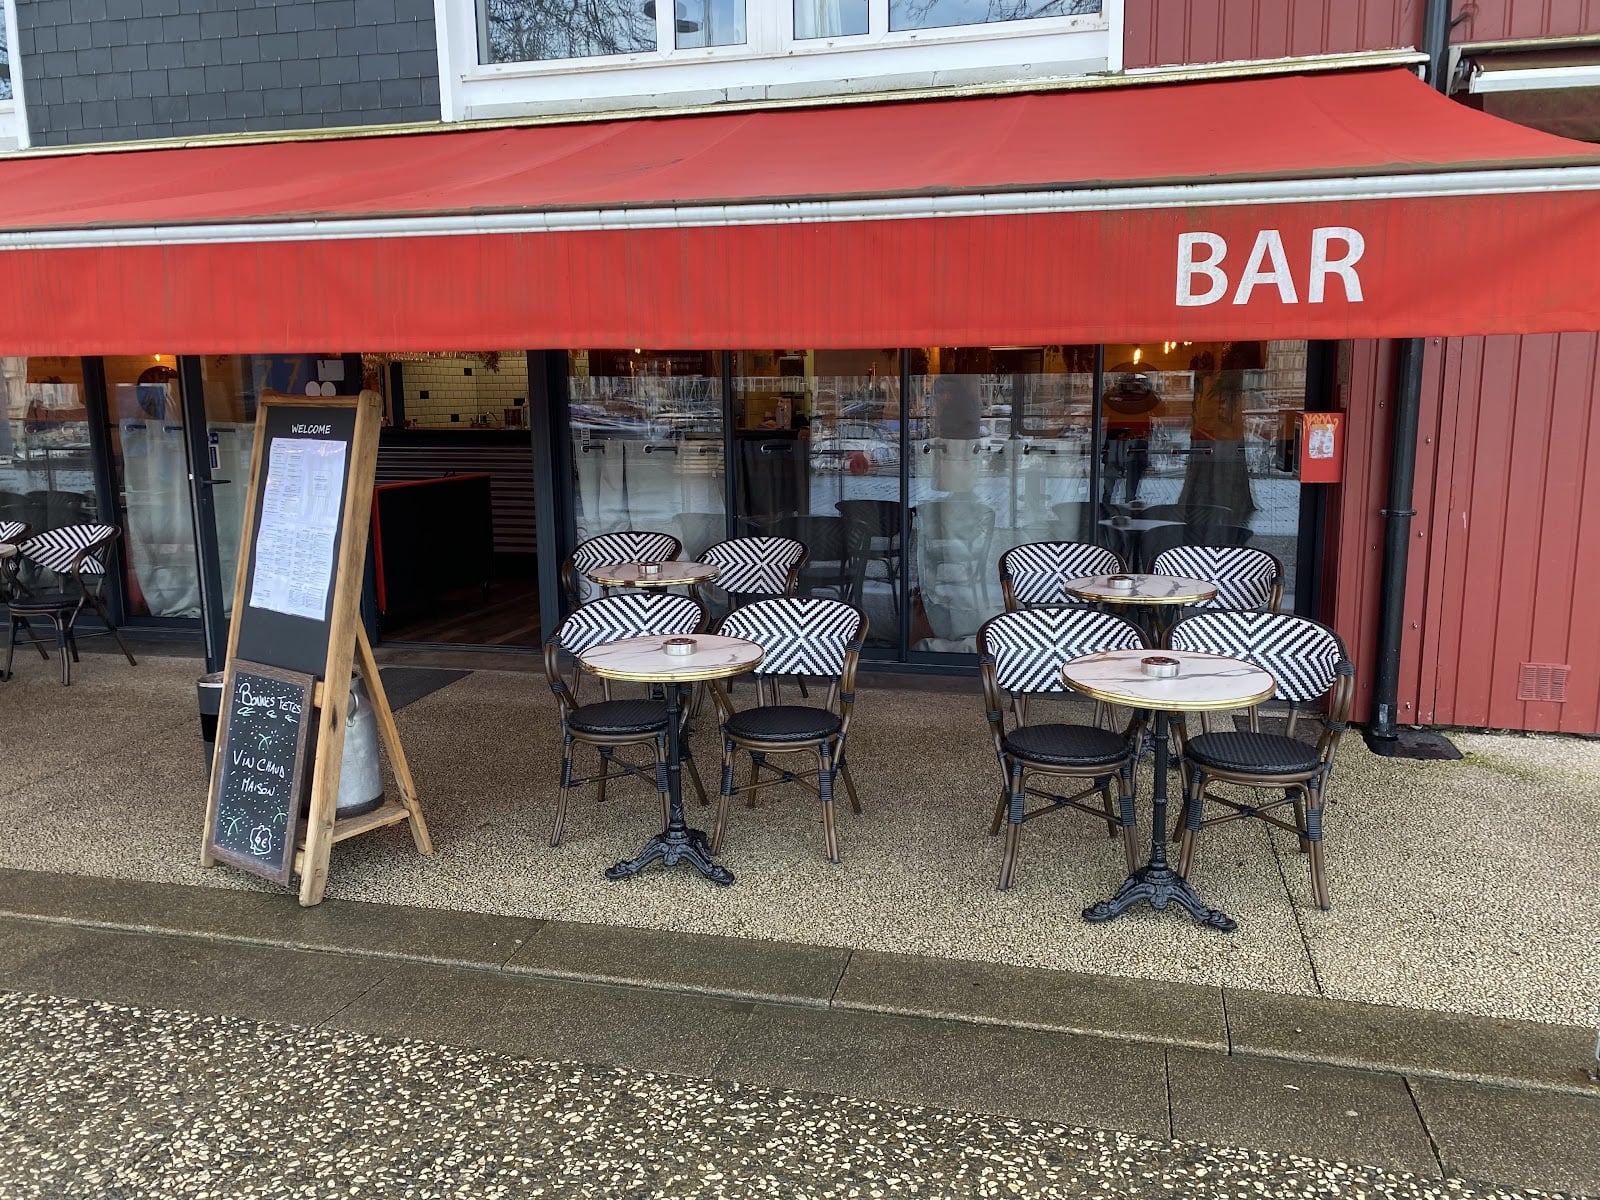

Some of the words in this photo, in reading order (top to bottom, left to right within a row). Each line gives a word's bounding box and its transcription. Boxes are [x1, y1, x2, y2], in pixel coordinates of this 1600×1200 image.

[1175, 226, 1365, 307] BAR
[291, 424, 332, 434] WELCOME
[256, 758, 285, 779] CHAUD
